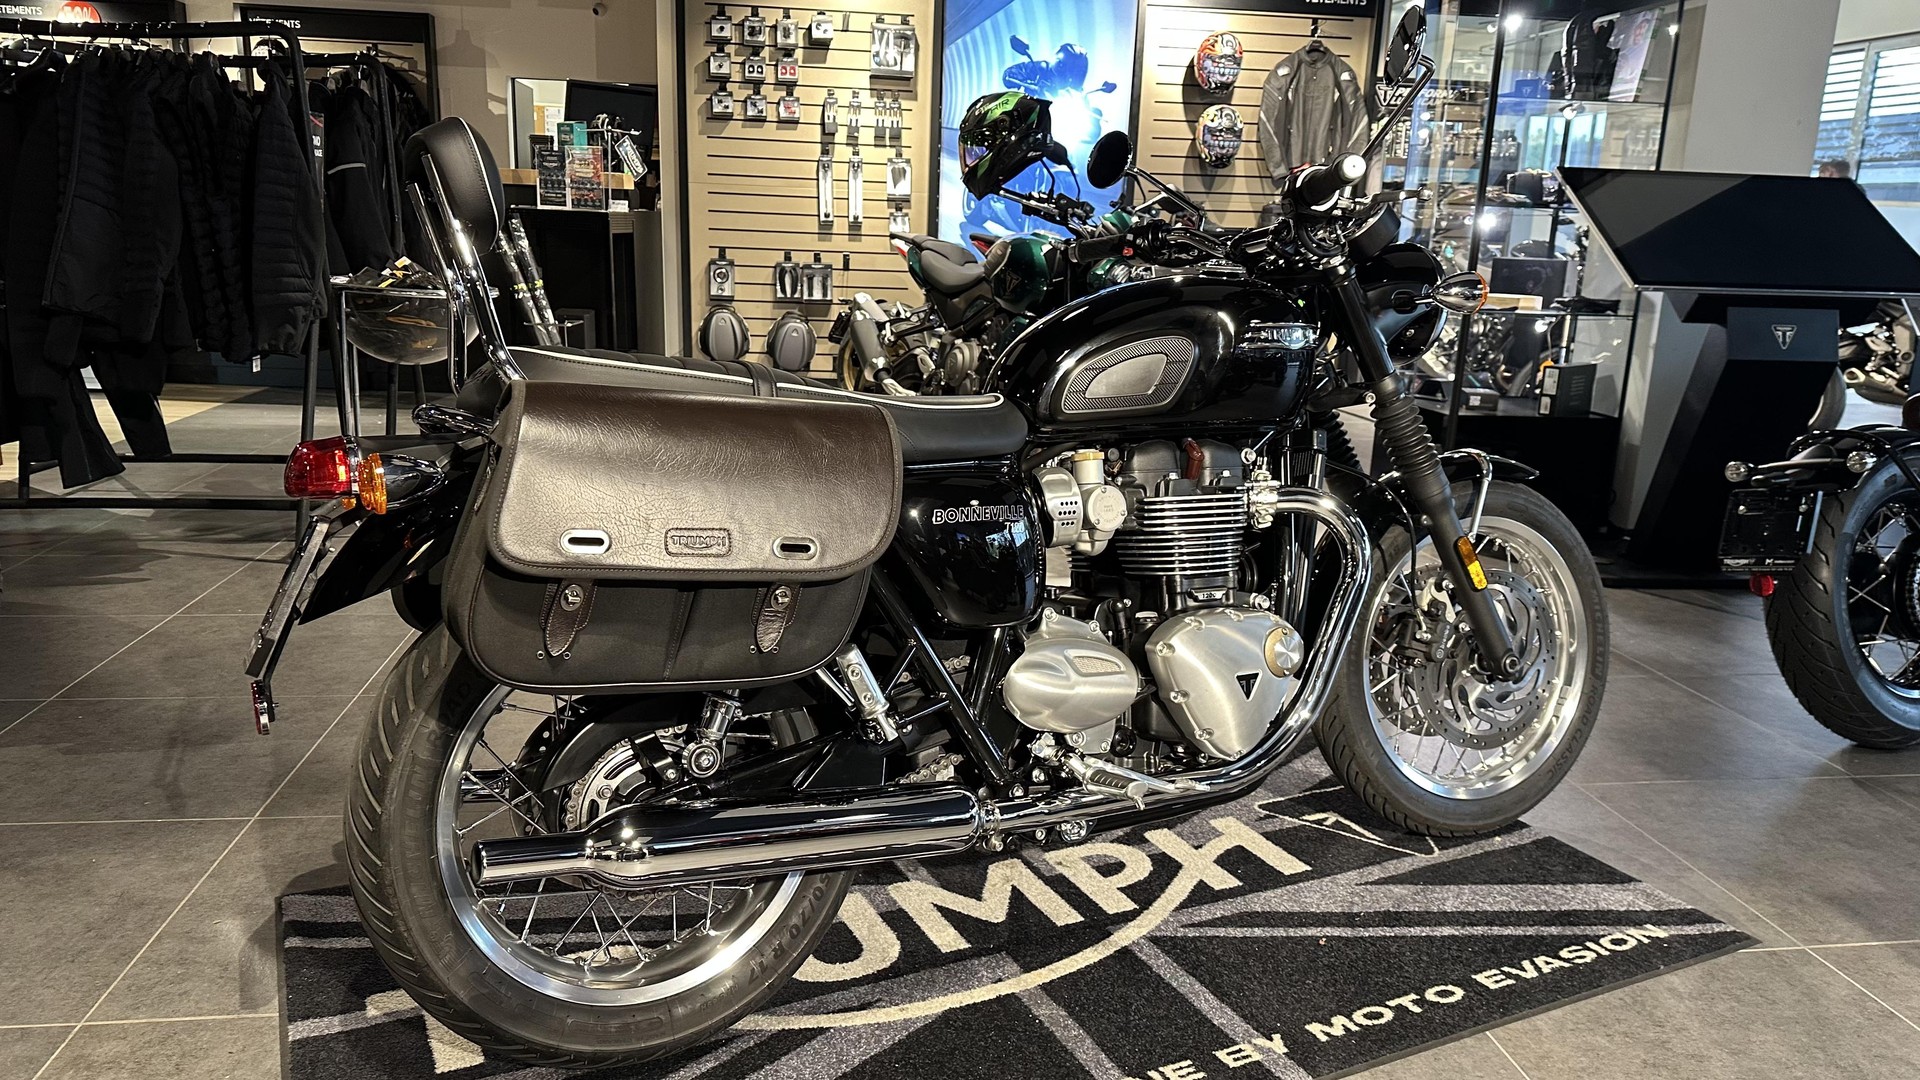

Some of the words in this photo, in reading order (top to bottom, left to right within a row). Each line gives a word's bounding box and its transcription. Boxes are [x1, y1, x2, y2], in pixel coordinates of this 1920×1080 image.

[932, 505, 1024, 524] BONNEVILLE
[670, 534, 727, 549] TRIUMPH
[1580, 684, 1599, 725] ROAD
[1549, 730, 1584, 778] CLASSIC
[788, 873, 832, 940] 50/70
[1212, 1033, 1290, 1069] BY
[1305, 984, 1465, 1042] MOTO
[1472, 924, 1668, 990] EVASION
